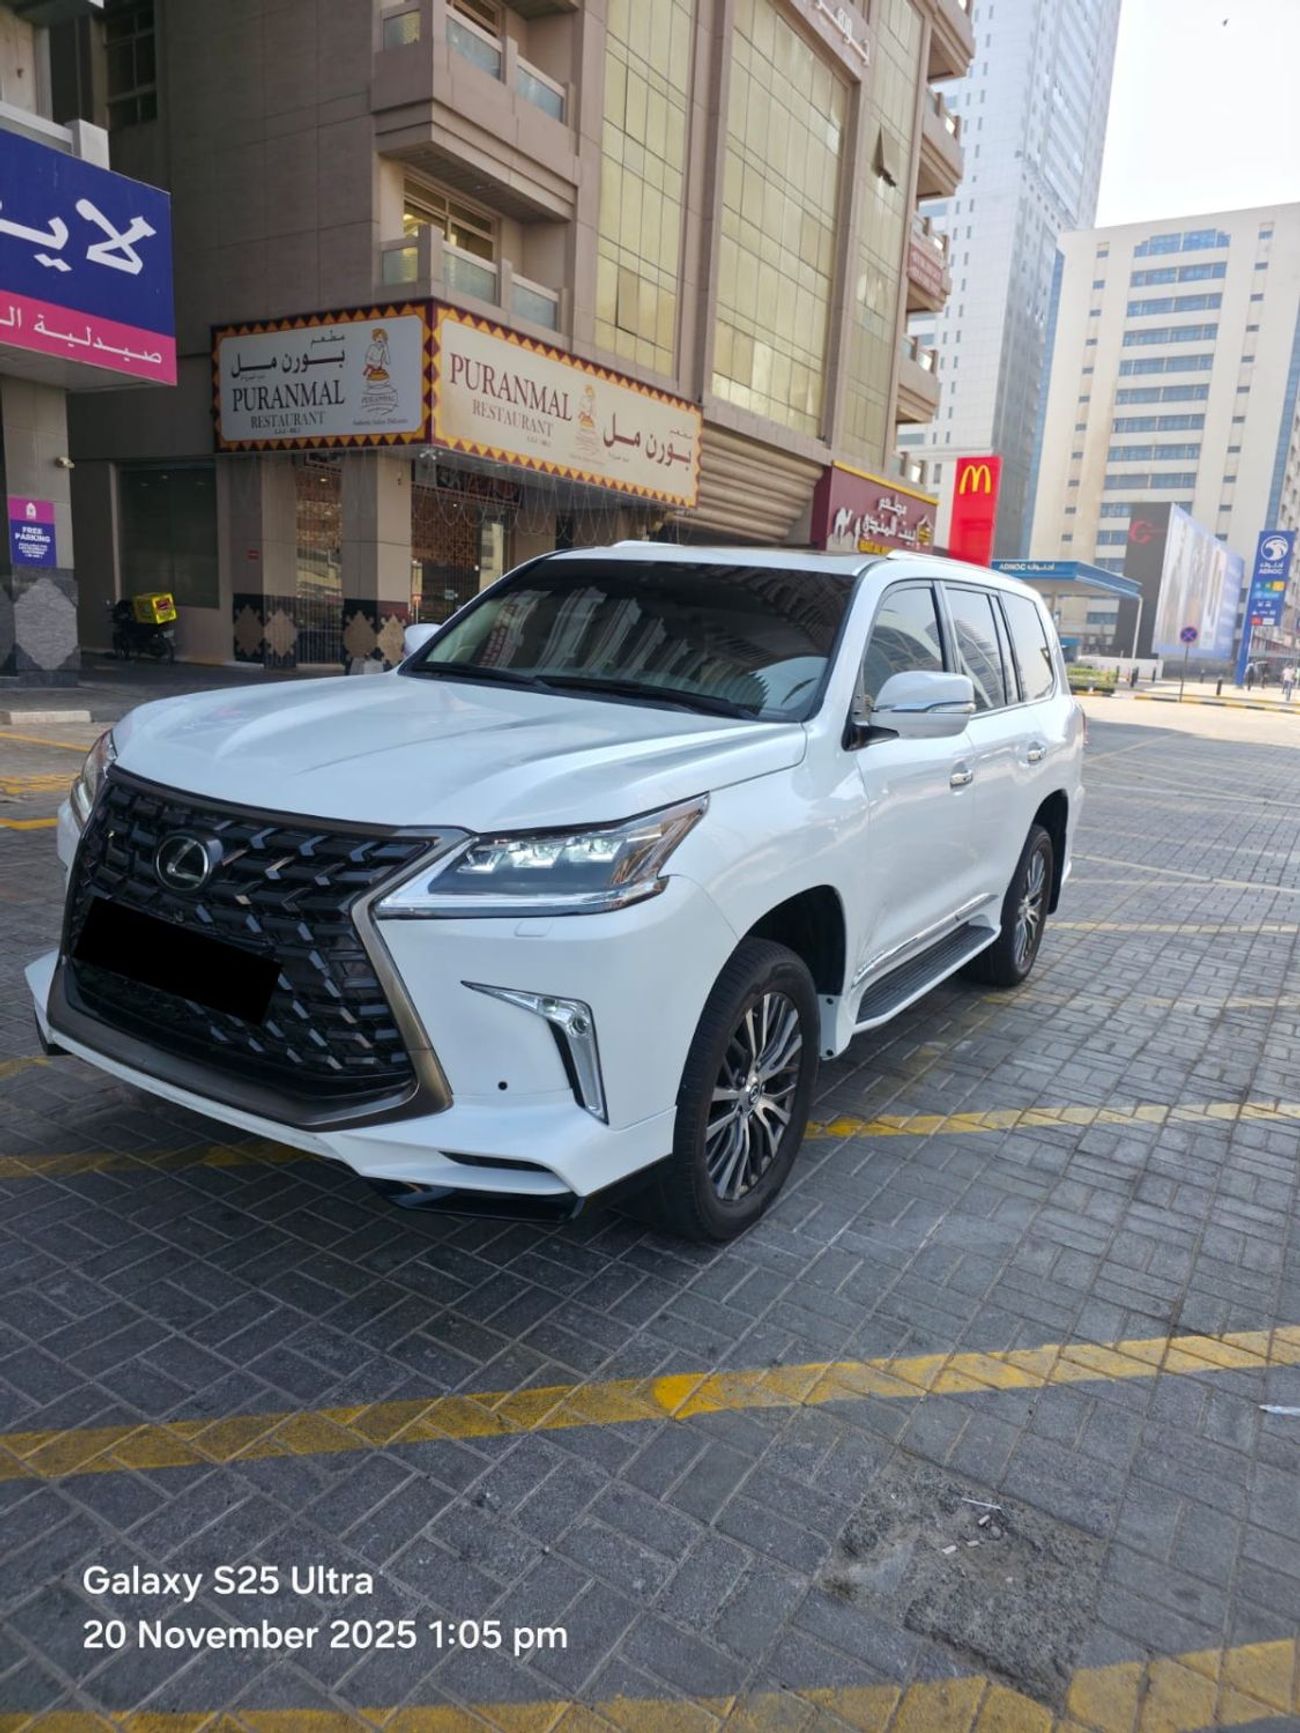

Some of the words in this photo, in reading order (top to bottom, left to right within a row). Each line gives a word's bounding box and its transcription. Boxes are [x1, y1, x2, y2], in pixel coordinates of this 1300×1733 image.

[0, 199, 157, 275] لاي
[0, 305, 22, 328] ال
[34, 314, 162, 363] صيدلية
[231, 352, 277, 379] مل
[281, 349, 345, 374] بورن
[232, 379, 345, 412] PURANMAL
[450, 353, 573, 421] PURANMAL
[251, 411, 326, 429] RESTAURANT
[472, 399, 553, 437] RESTAURANT
[603, 411, 640, 448] مل
[645, 433, 691, 471] بورن
[15, 532, 51, 543] PARKING
[22, 526, 43, 535] FREE
